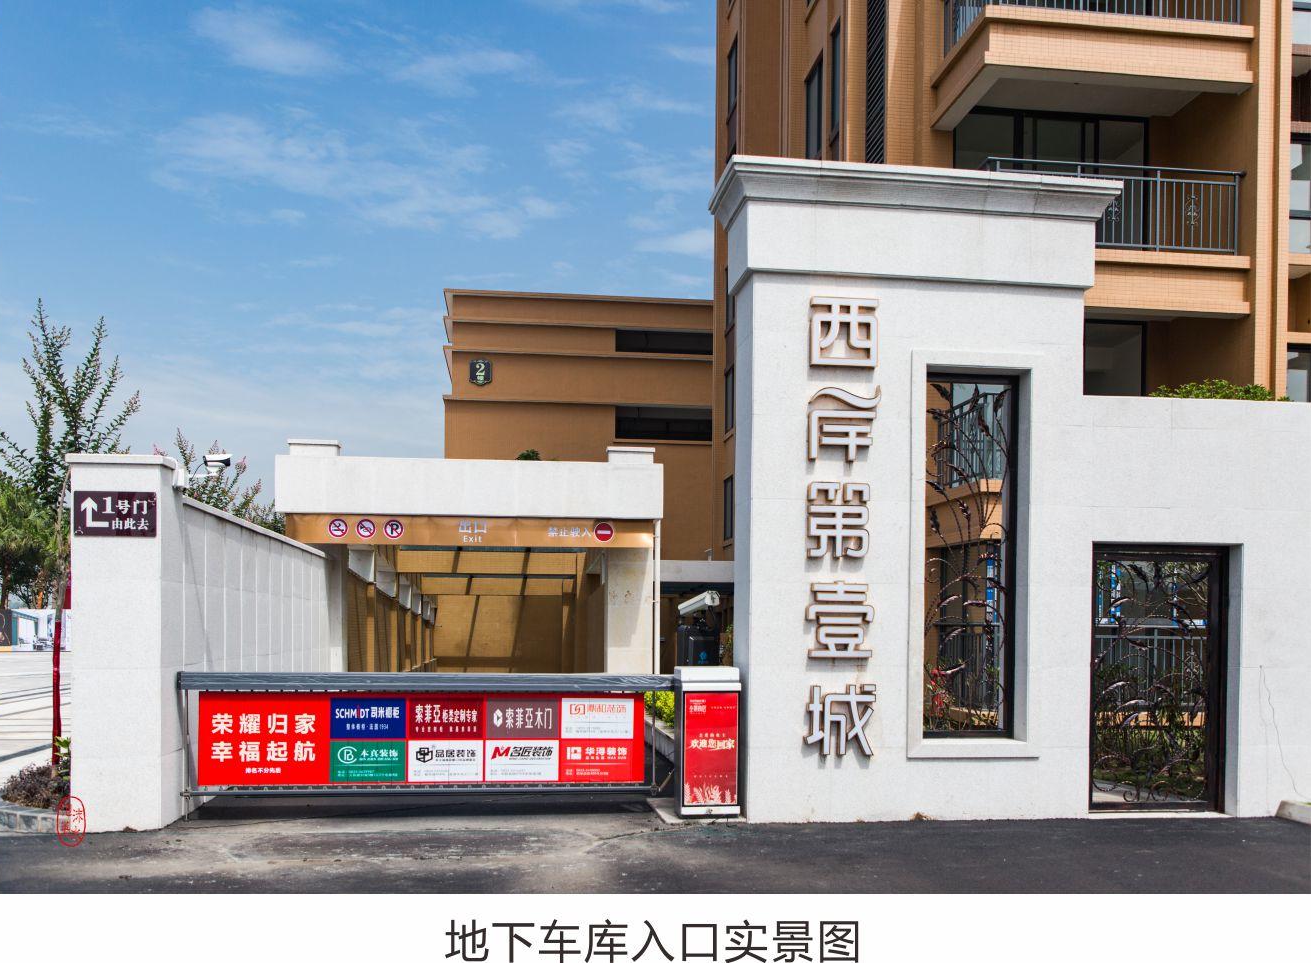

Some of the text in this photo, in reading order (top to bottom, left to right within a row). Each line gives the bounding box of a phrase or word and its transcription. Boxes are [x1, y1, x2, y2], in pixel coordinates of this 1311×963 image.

[475, 362, 485, 376] 2
[102, 496, 148, 514] 1号门
[112, 518, 149, 530] 由此去
[458, 519, 487, 533] 出口
[804, 295, 881, 757] 西岸第壹城
[547, 527, 592, 537] 禁止驶入
[463, 535, 482, 543] Exit
[211, 713, 316, 734] 荣耀归家
[689, 738, 735, 750] 欢迎您回家
[211, 740, 316, 762] 幸福起航
[360, 749, 399, 758] 本真装饰
[435, 749, 477, 758] 品居装饰
[510, 746, 554, 757] 名匠装饰
